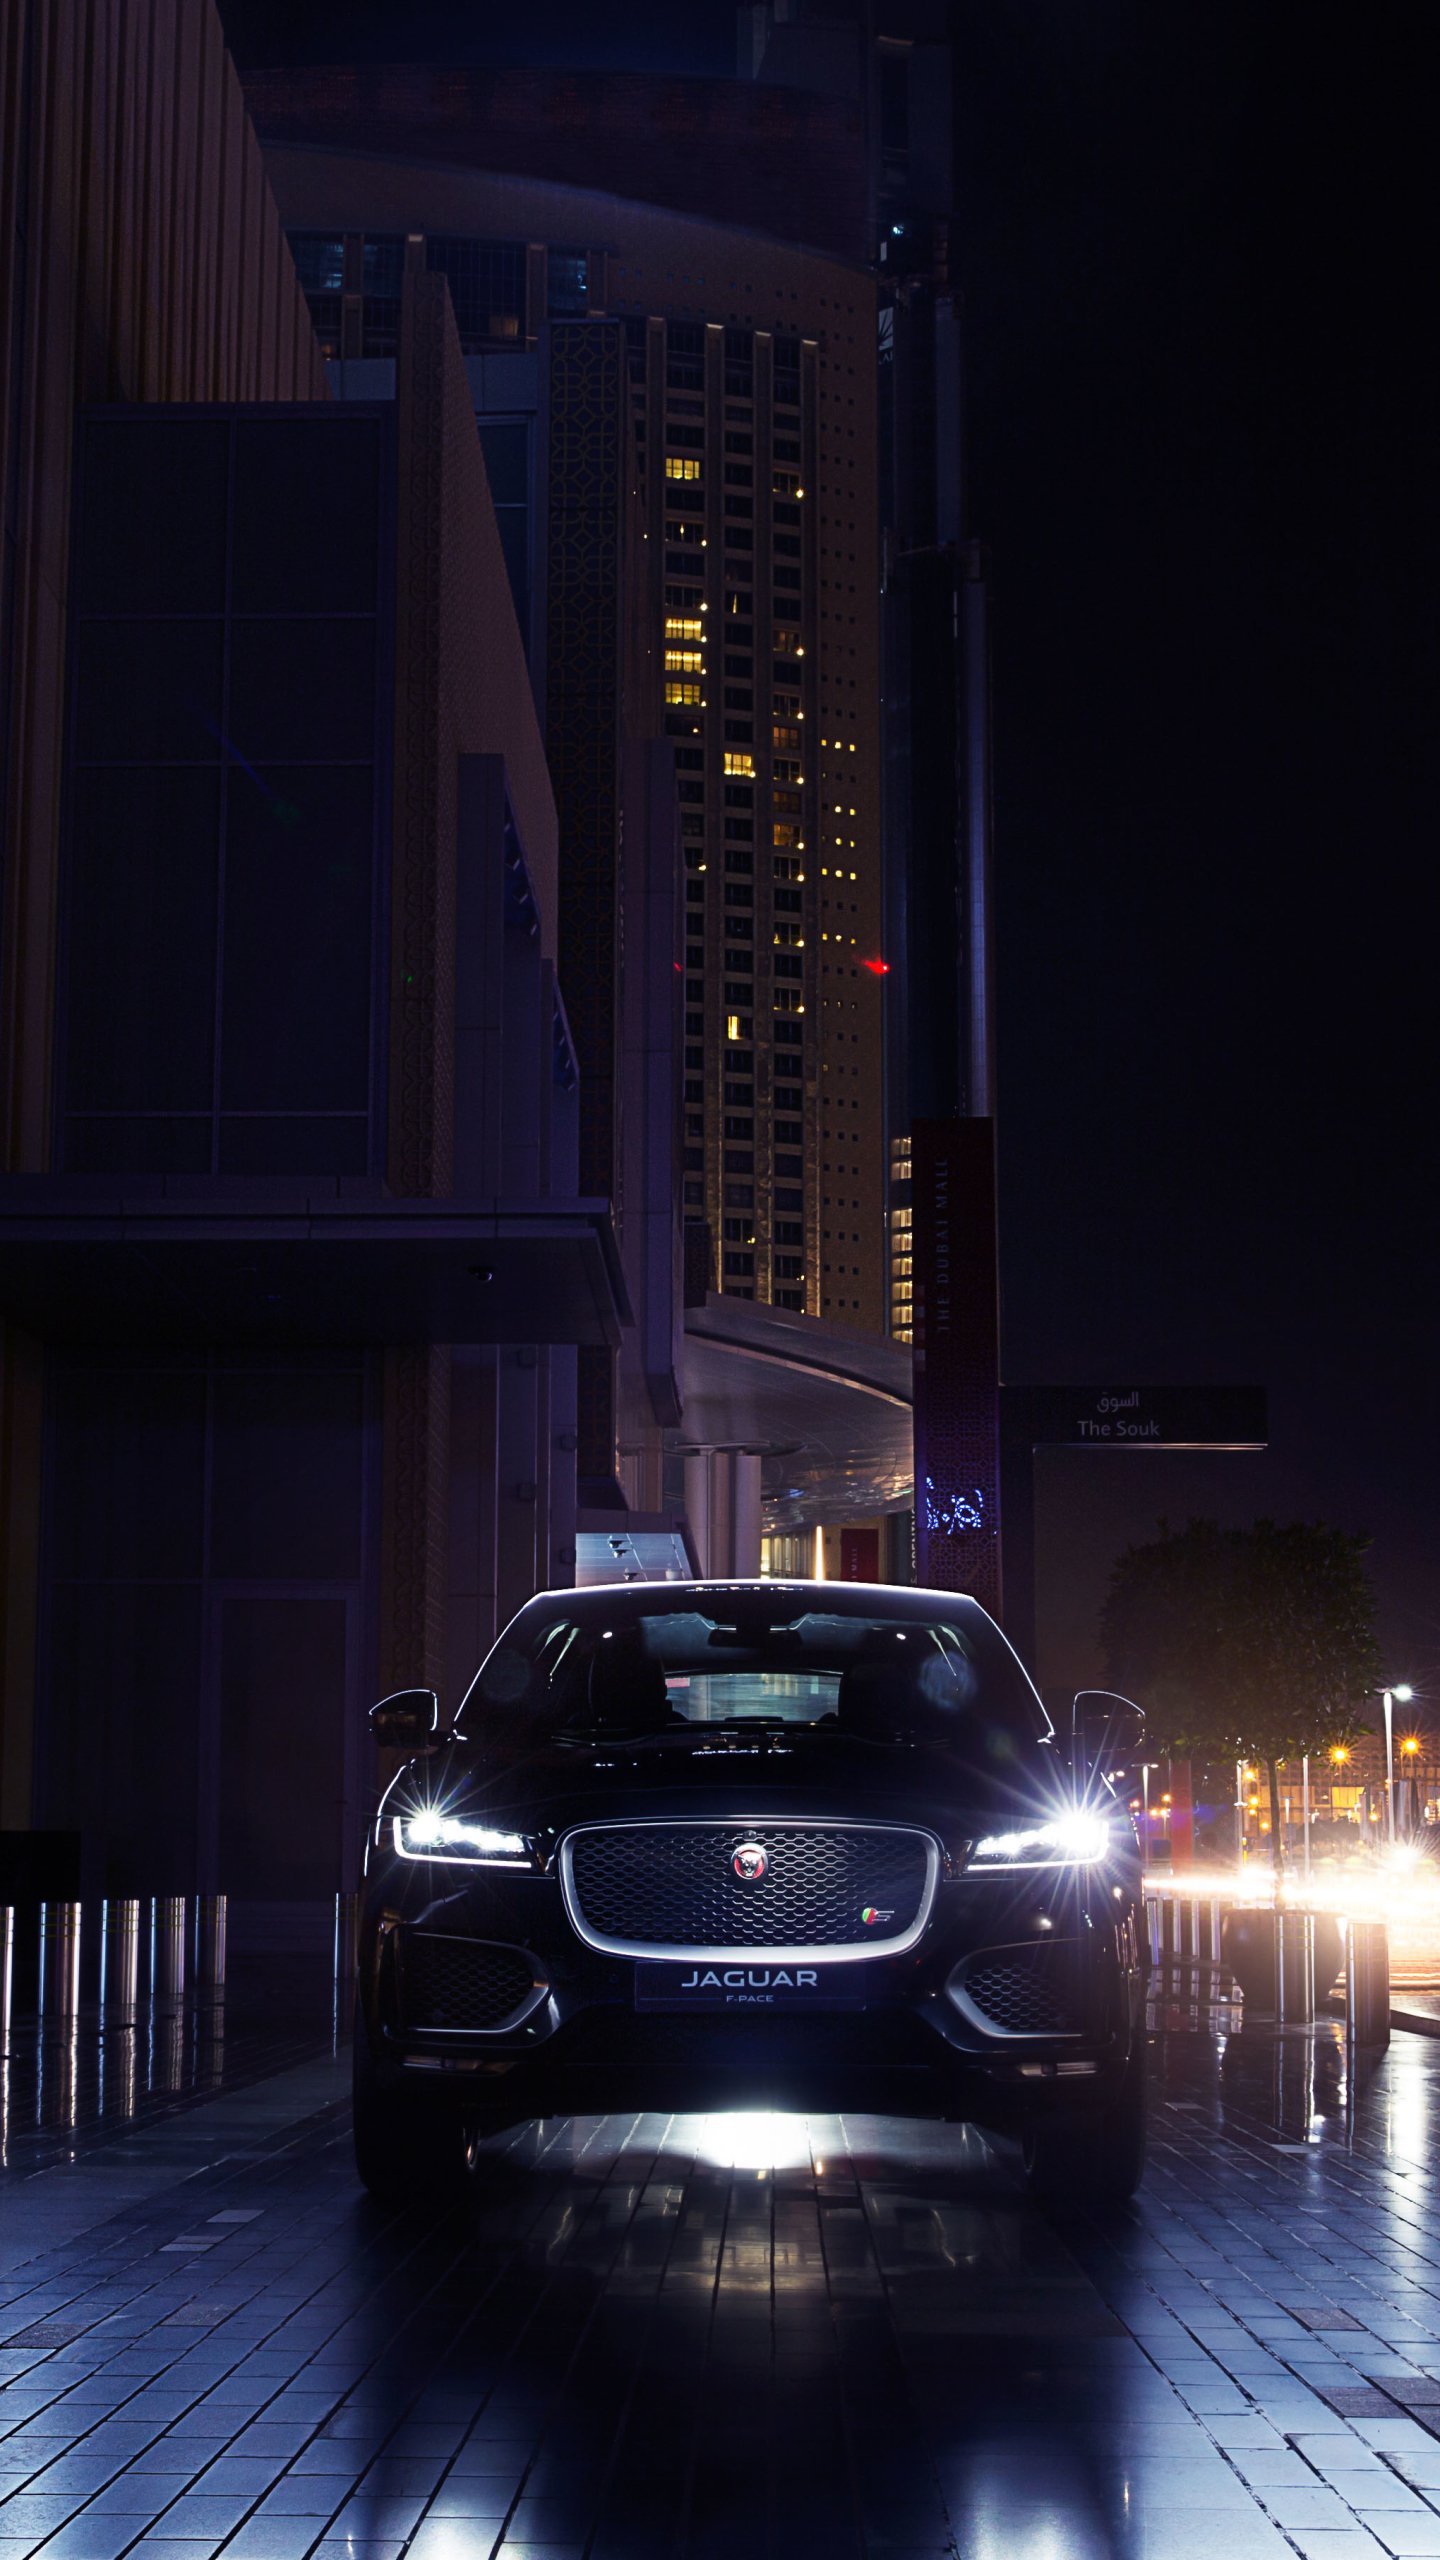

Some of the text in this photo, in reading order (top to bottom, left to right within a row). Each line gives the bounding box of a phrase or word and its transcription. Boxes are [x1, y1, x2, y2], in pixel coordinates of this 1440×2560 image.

[935, 1158, 950, 1333] THE DUBAI MALL
[1096, 1391, 1140, 1413] السوق
[1076, 1420, 1160, 1436] The Souk
[681, 1970, 818, 1987] JAGUAR
[726, 1995, 774, 2003] F-PACE
